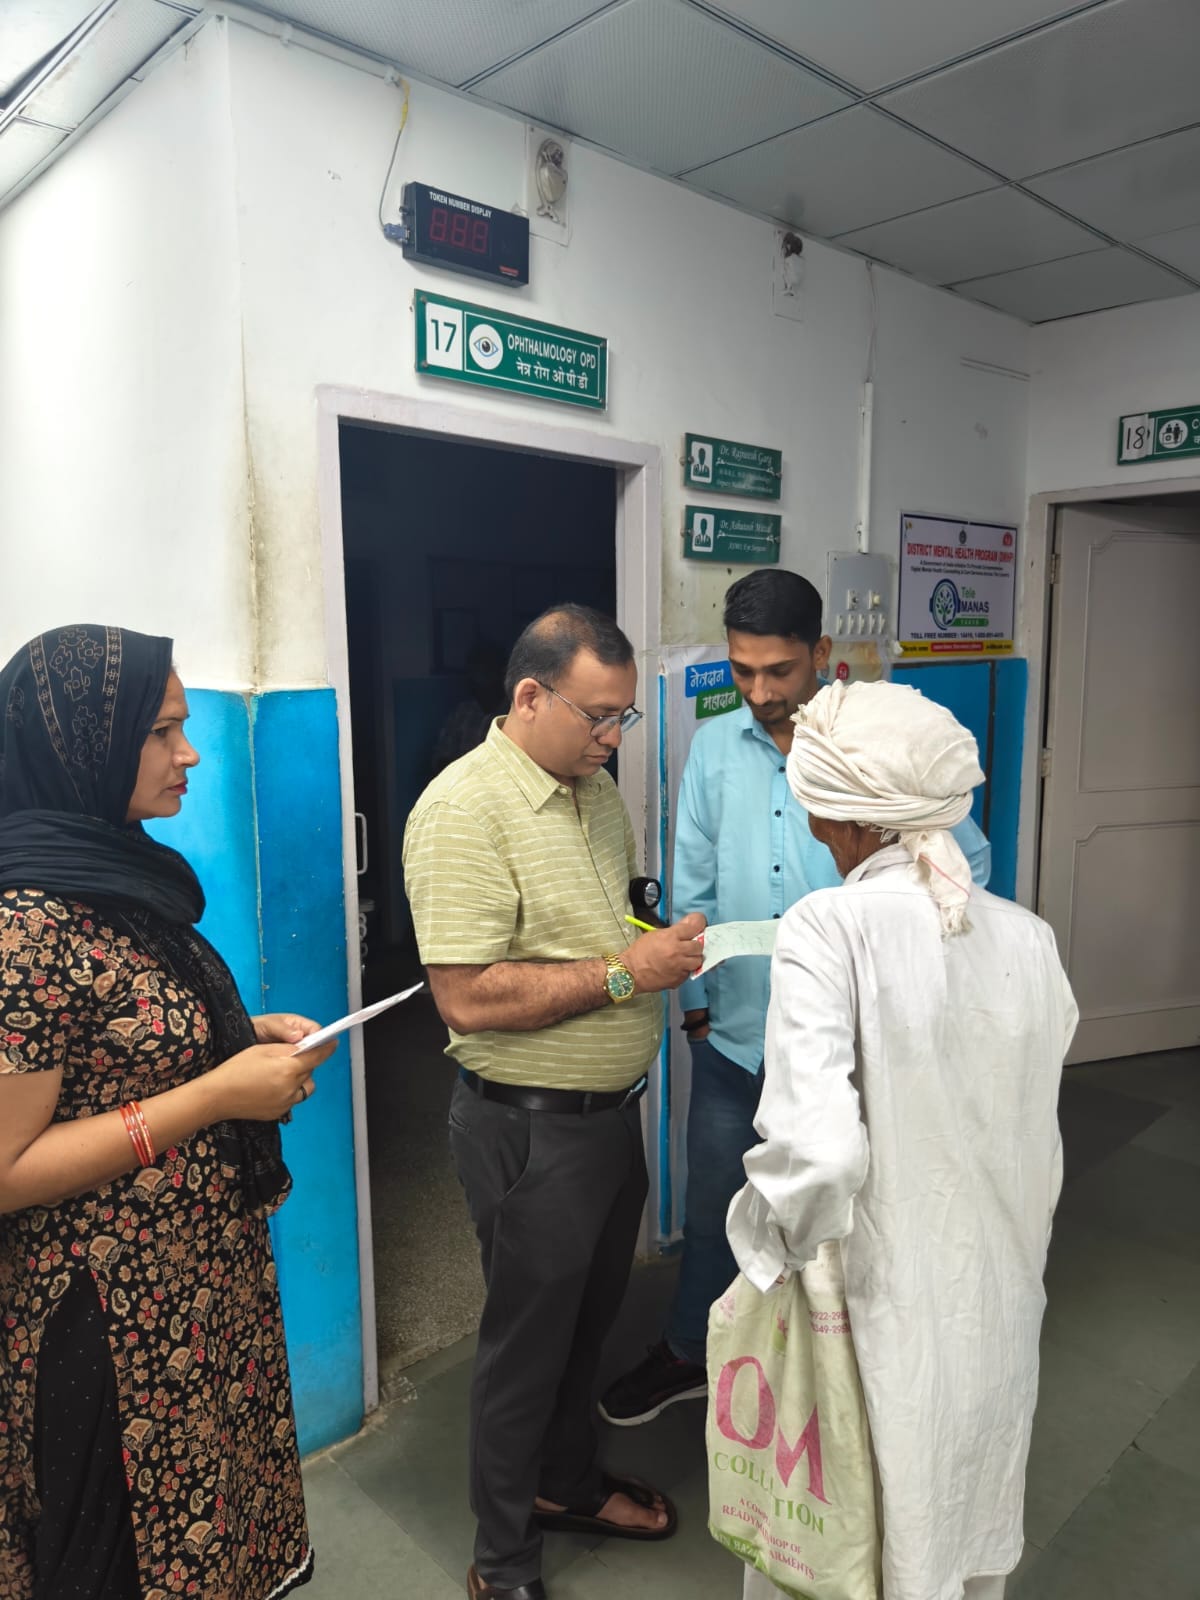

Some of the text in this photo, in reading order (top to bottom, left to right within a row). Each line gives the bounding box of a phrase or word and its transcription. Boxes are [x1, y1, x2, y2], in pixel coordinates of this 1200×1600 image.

[429, 191, 492, 218] TOKEN NUMBER DISPLAY
[431, 318, 457, 353] 17
[507, 333, 597, 370] OPHTHALMOLOGY OPD
[516, 356, 532, 377] नेत्र
[533, 361, 550, 381] रोग
[1126, 425, 1146, 450] 18
[907, 542, 932, 557] DISTRICT
[933, 544, 954, 559] MENTAL
[955, 546, 974, 560] HEALTH
[975, 548, 998, 562] PROGRAM
[961, 586, 976, 599] Tele
[960, 600, 990, 614] MANAS
[924, 632, 937, 640] FREE
[690, 668, 724, 688] नेत्रदान
[703, 691, 736, 709] महादान
